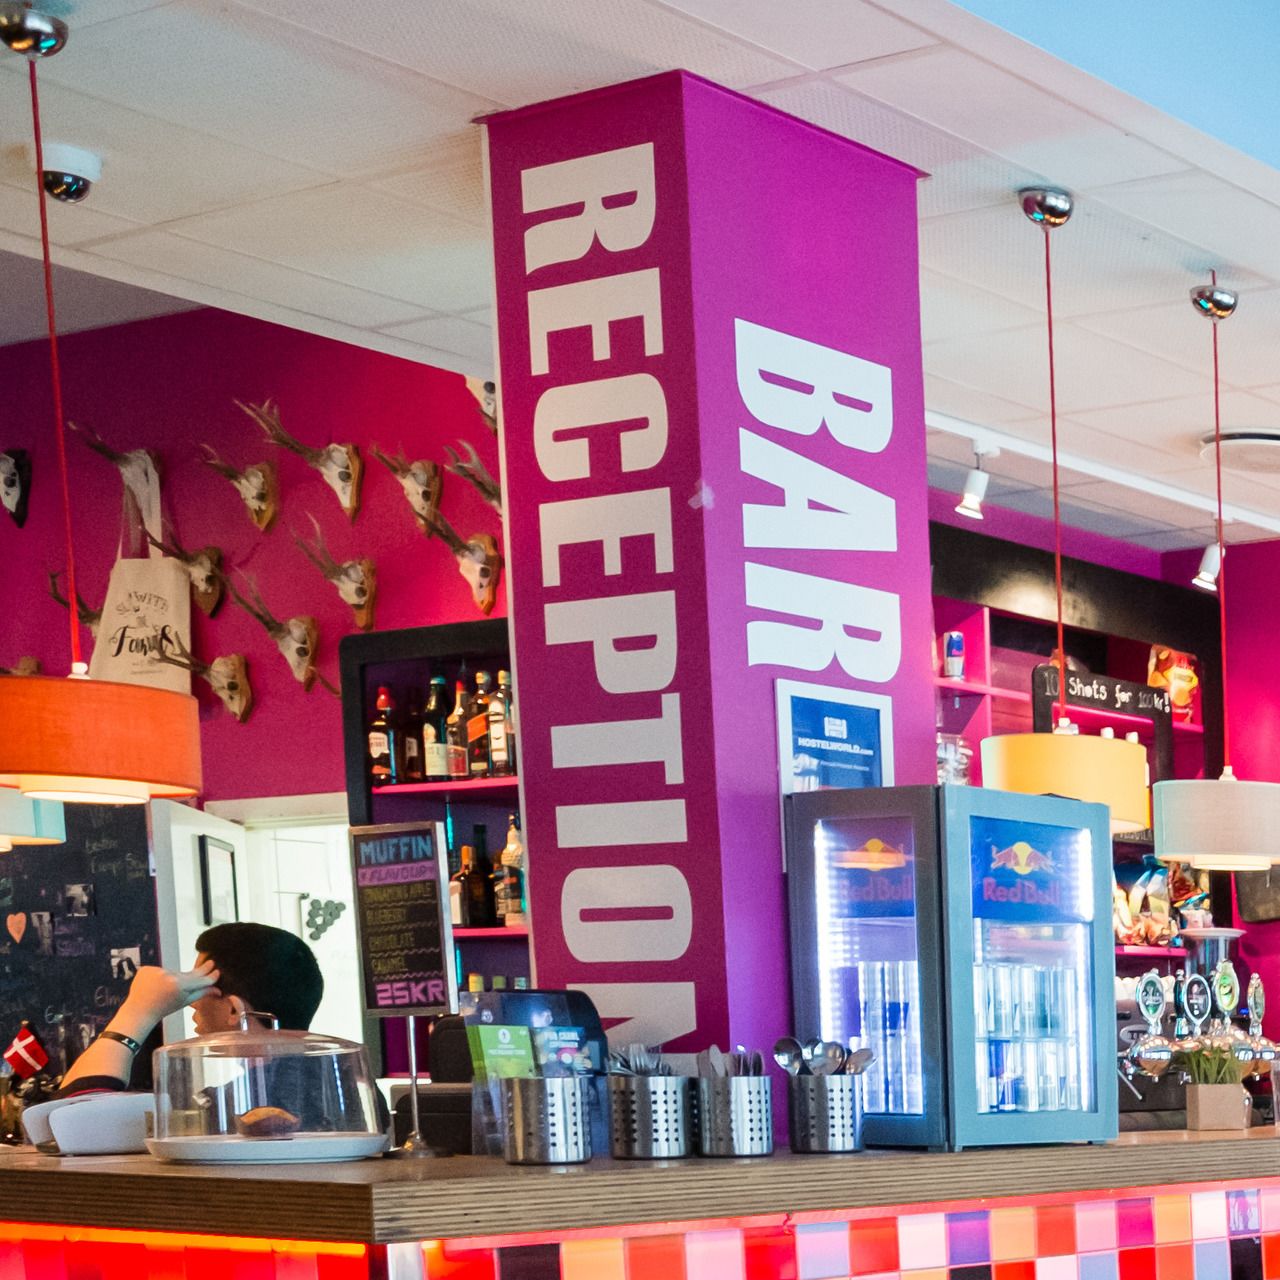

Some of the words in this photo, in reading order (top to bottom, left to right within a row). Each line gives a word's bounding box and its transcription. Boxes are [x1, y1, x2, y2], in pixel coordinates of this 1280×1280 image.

[734, 317, 902, 683] BAR
[521, 142, 700, 1076] RECEPTION
[1069, 677, 1108, 701] Shots
[1115, 684, 1133, 709] for
[360, 835, 432, 866] MUFFIN
[982, 876, 1022, 902] Red
